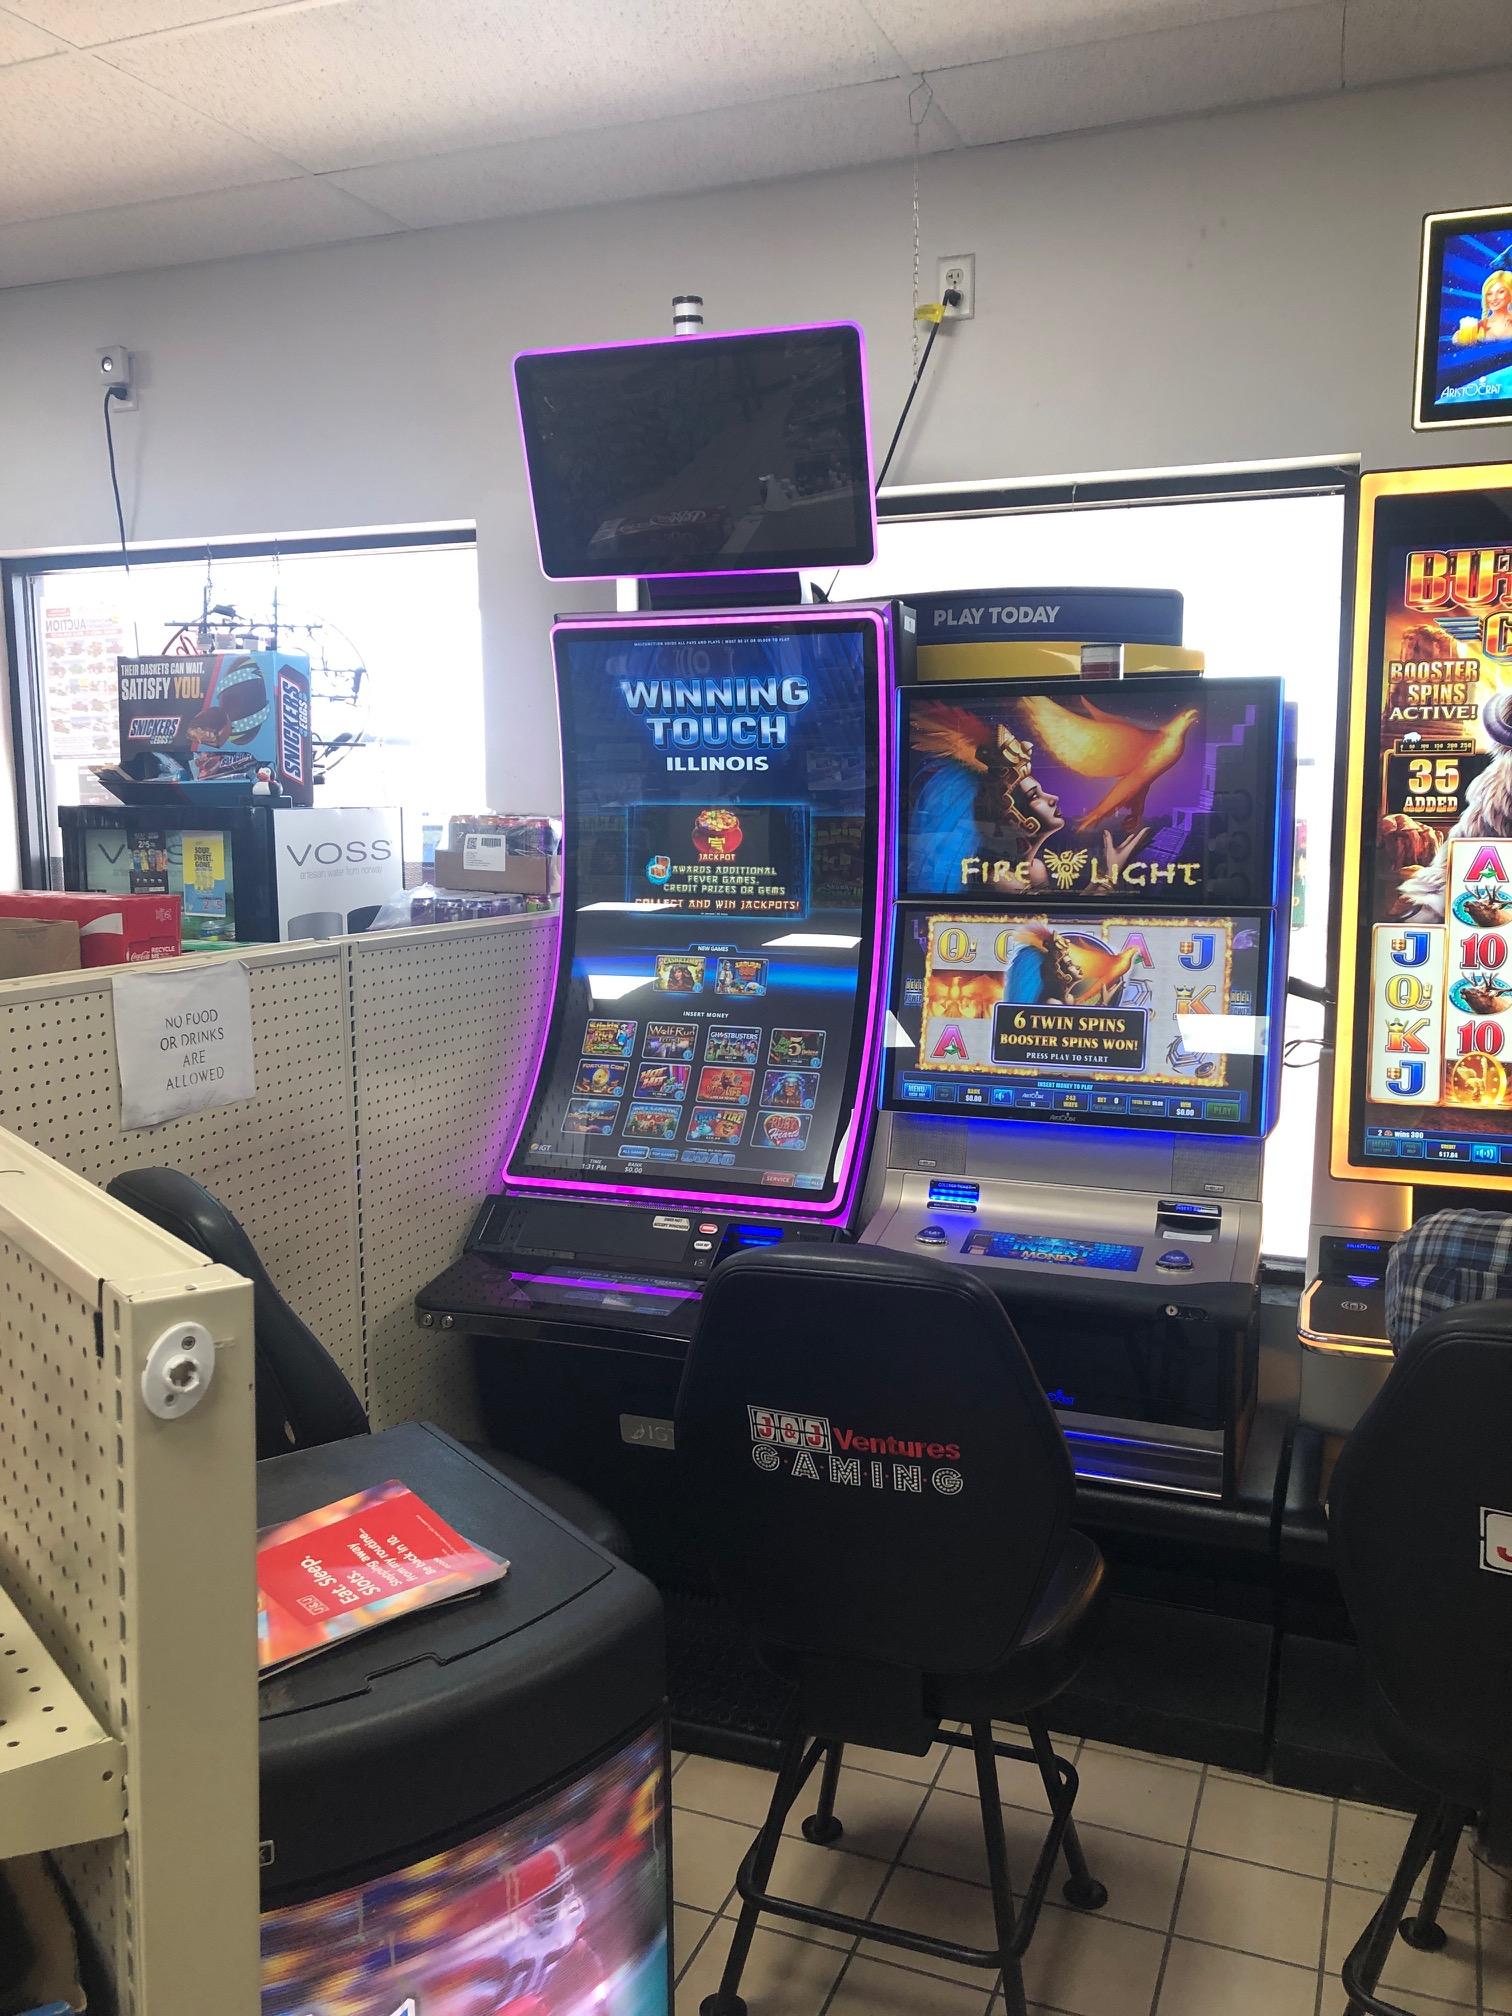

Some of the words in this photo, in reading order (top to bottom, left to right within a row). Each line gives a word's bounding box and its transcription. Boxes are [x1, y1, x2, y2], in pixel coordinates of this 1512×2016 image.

[1441, 384, 1502, 398] ARISTOCRAT
[934, 608, 984, 626] PLAY
[989, 606, 1060, 624] TODAY
[121, 663, 138, 676] THEIR
[140, 662, 169, 675] BASKETS
[171, 662, 185, 674] CAN
[186, 661, 205, 674] WAIT.
[1391, 661, 1478, 682] BOOSTER
[121, 677, 171, 700] SATISFY
[174, 676, 204, 699] YOU.
[620, 676, 809, 713] WINNING
[1408, 683, 1466, 705] SPINS
[298, 698, 307, 731] EGGS
[1390, 705, 1477, 720] ACTIVE!
[130, 719, 178, 737] SNICKERS
[281, 679, 302, 779] SNICKERS
[646, 715, 788, 749] TOUCH
[152, 735, 169, 745] EGGS
[666, 756, 769, 771] ILLINOIS
[1408, 758, 1459, 794] 35
[1403, 796, 1458, 813] ADDED
[286, 840, 391, 866] VOSS
[1463, 845, 1509, 882] A
[328, 868, 344, 878] water
[673, 866, 711, 874] AWARDS
[715, 866, 777, 876] ADDITIONAL
[961, 857, 1031, 884] FIRE
[1091, 857, 1200, 887] LIGHT
[664, 884, 697, 892] CREDIT
[701, 885, 736, 894] PRIZES
[740, 886, 754, 894] OR
[758, 887, 785, 895] GEMS
[688, 900, 710, 908] AND
[716, 900, 736, 909] WIN
[740, 901, 799, 910] JACKPOTS!
[938, 928, 977, 963] Q
[1178, 933, 1216, 971] J
[1391, 931, 1430, 968] J
[1459, 932, 1508, 970] 10
[1385, 973, 1432, 1011] Q
[165, 1016, 182, 1028] NO
[186, 1009, 218, 1025] FOOD
[1014, 1010, 1026, 1029] 6
[1030, 1015, 1074, 1030] TWIN
[1079, 1017, 1126, 1032] SPINS
[160, 1036, 178, 1051] OR
[181, 1027, 224, 1046] DRINKS
[649, 1025, 675, 1036] Wolf
[676, 1026, 695, 1036] Run
[1385, 1018, 1430, 1054] K
[1457, 1020, 1505, 1056] 10
[930, 1024, 969, 1060] A
[1000, 1033, 1058, 1047] BOOSTER
[1061, 1036, 1098, 1049] SPINS
[1102, 1039, 1138, 1050] WON!
[183, 1050, 206, 1067] ARE
[1026, 1052, 1048, 1060] PRESS
[1084, 1055, 1108, 1063] START
[166, 1066, 224, 1091] ALLOWED
[1386, 1059, 1426, 1096] J
[1021, 1251, 1078, 1262] MONEY
[833, 1427, 960, 1460] Ventures
[347, 1543, 370, 1562] away
[397, 1543, 409, 1554] in
[385, 1557, 401, 1570] my
[404, 1552, 425, 1568] back
[423, 1566, 437, 1575] Be
[301, 1556, 337, 1587] Sleep.
[367, 1560, 403, 1587] Stepping
[398, 1566, 418, 1582] from
[331, 1584, 360, 1604] Eat.
[347, 1571, 381, 1596] Slots.
